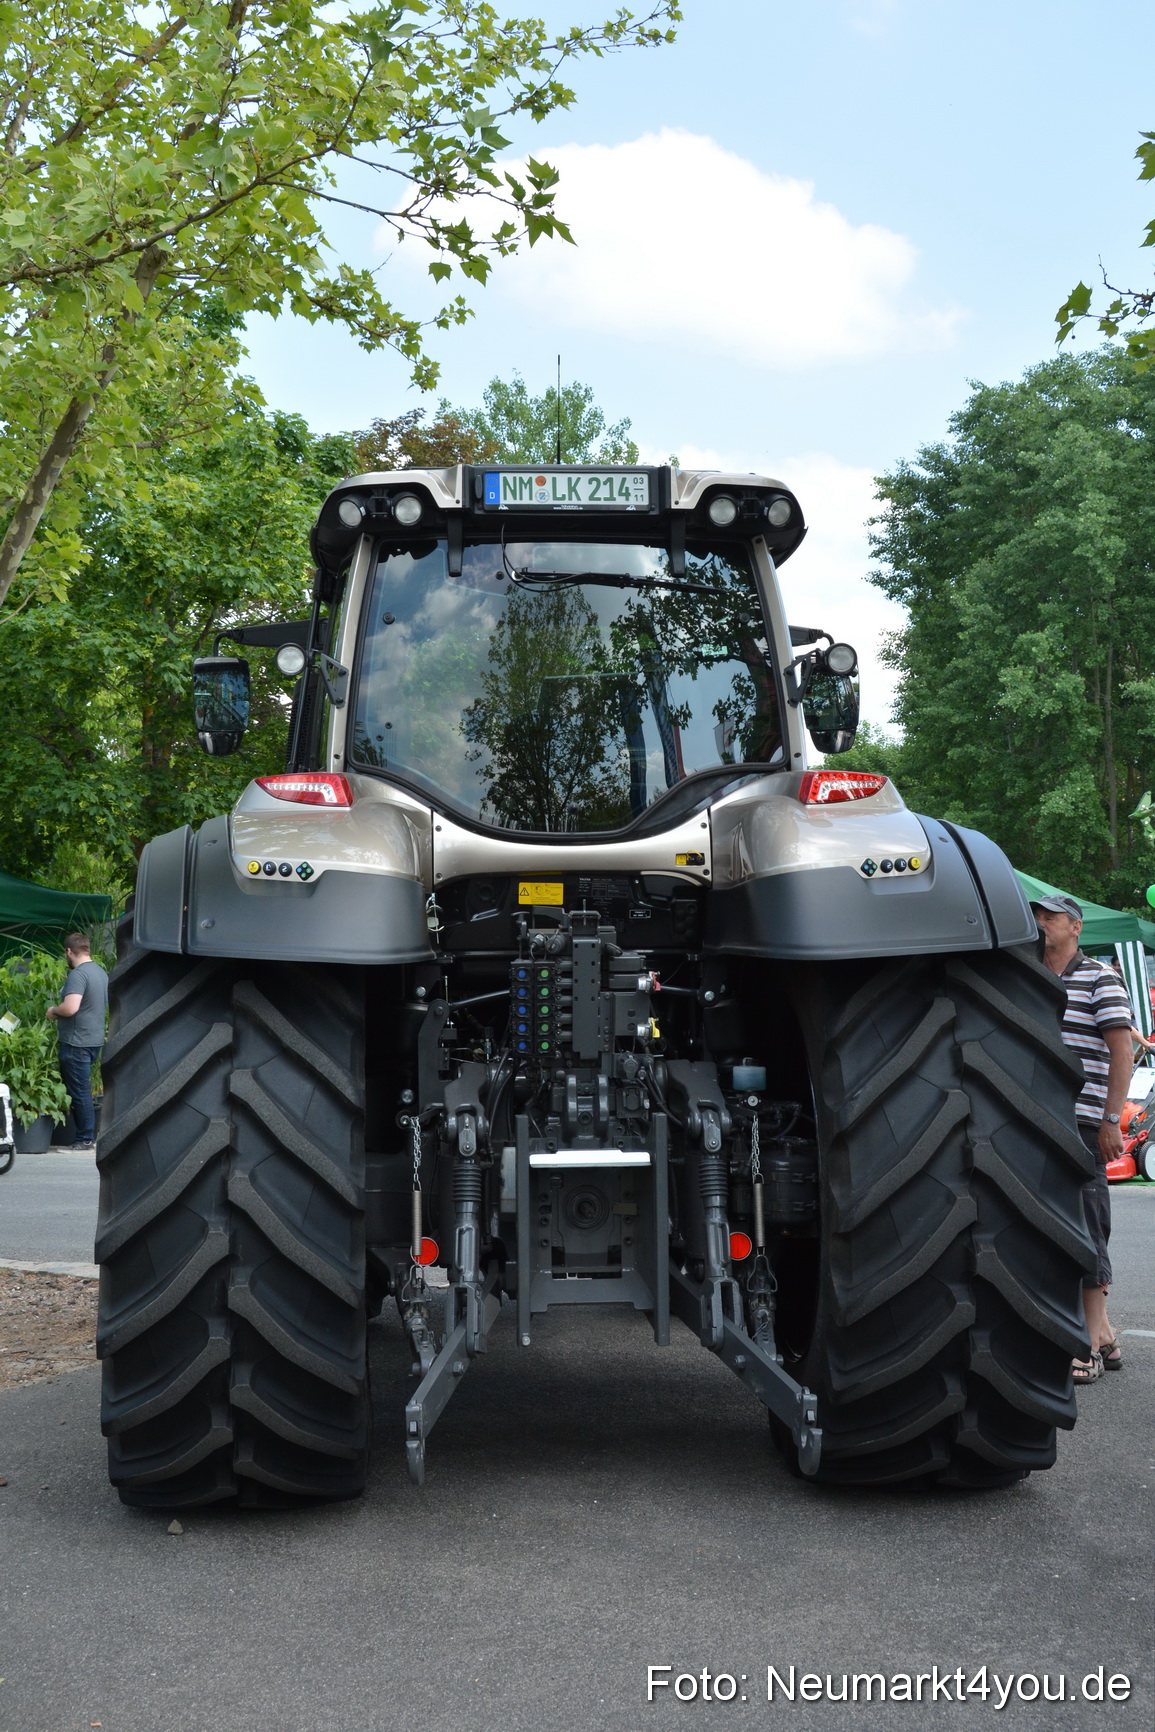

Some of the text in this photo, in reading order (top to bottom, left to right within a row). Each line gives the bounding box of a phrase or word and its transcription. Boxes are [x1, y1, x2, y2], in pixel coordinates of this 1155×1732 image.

[489, 491, 496, 499] D
[502, 476, 631, 501] NM LK 214
